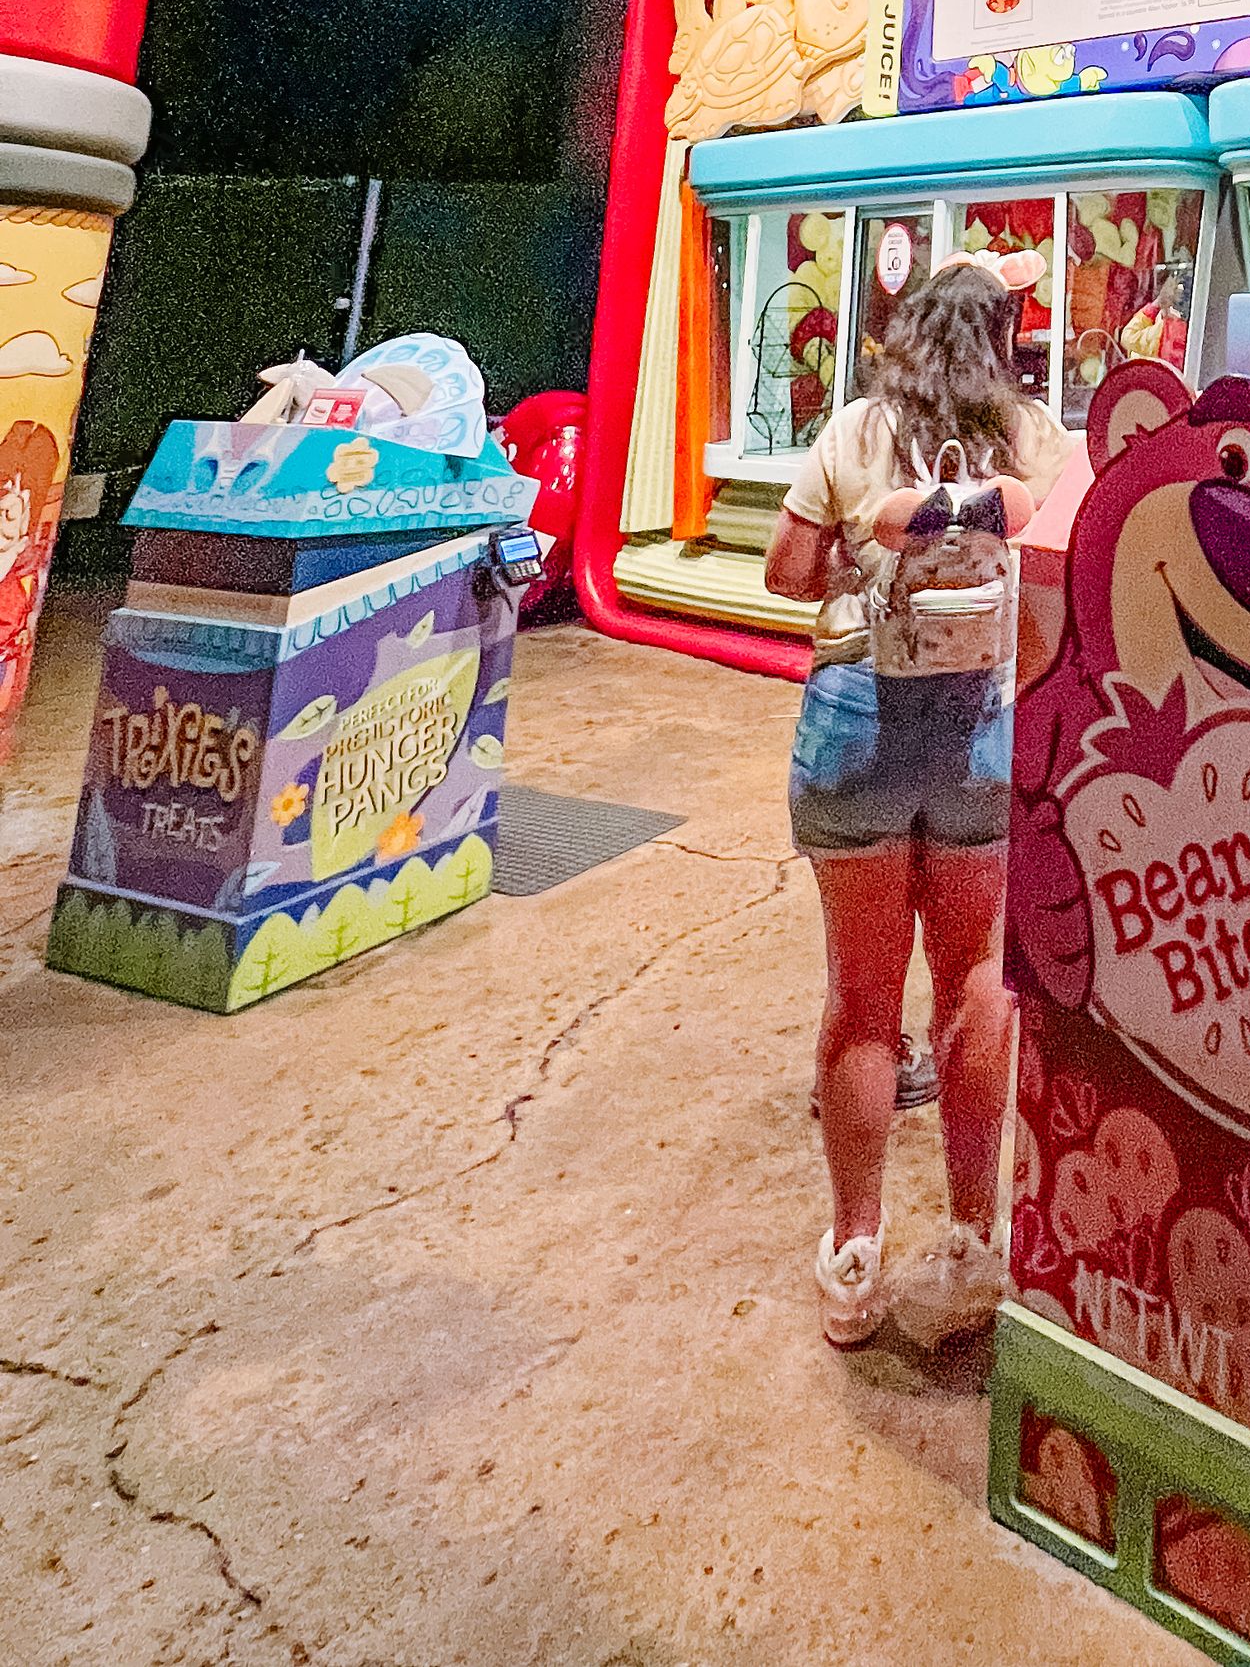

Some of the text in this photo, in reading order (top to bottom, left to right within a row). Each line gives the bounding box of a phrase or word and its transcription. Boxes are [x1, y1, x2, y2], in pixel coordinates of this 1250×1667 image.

[878, 3, 897, 102] JUICE!
[325, 690, 453, 763] PREHISTORIC
[340, 678, 439, 731] PERFECT FOR
[320, 711, 458, 806] HUNGER
[330, 748, 448, 837] PANGS
[141, 799, 226, 852] TREATS
[1070, 1259, 1160, 1361] NET
[1163, 1300, 1234, 1403] WT
